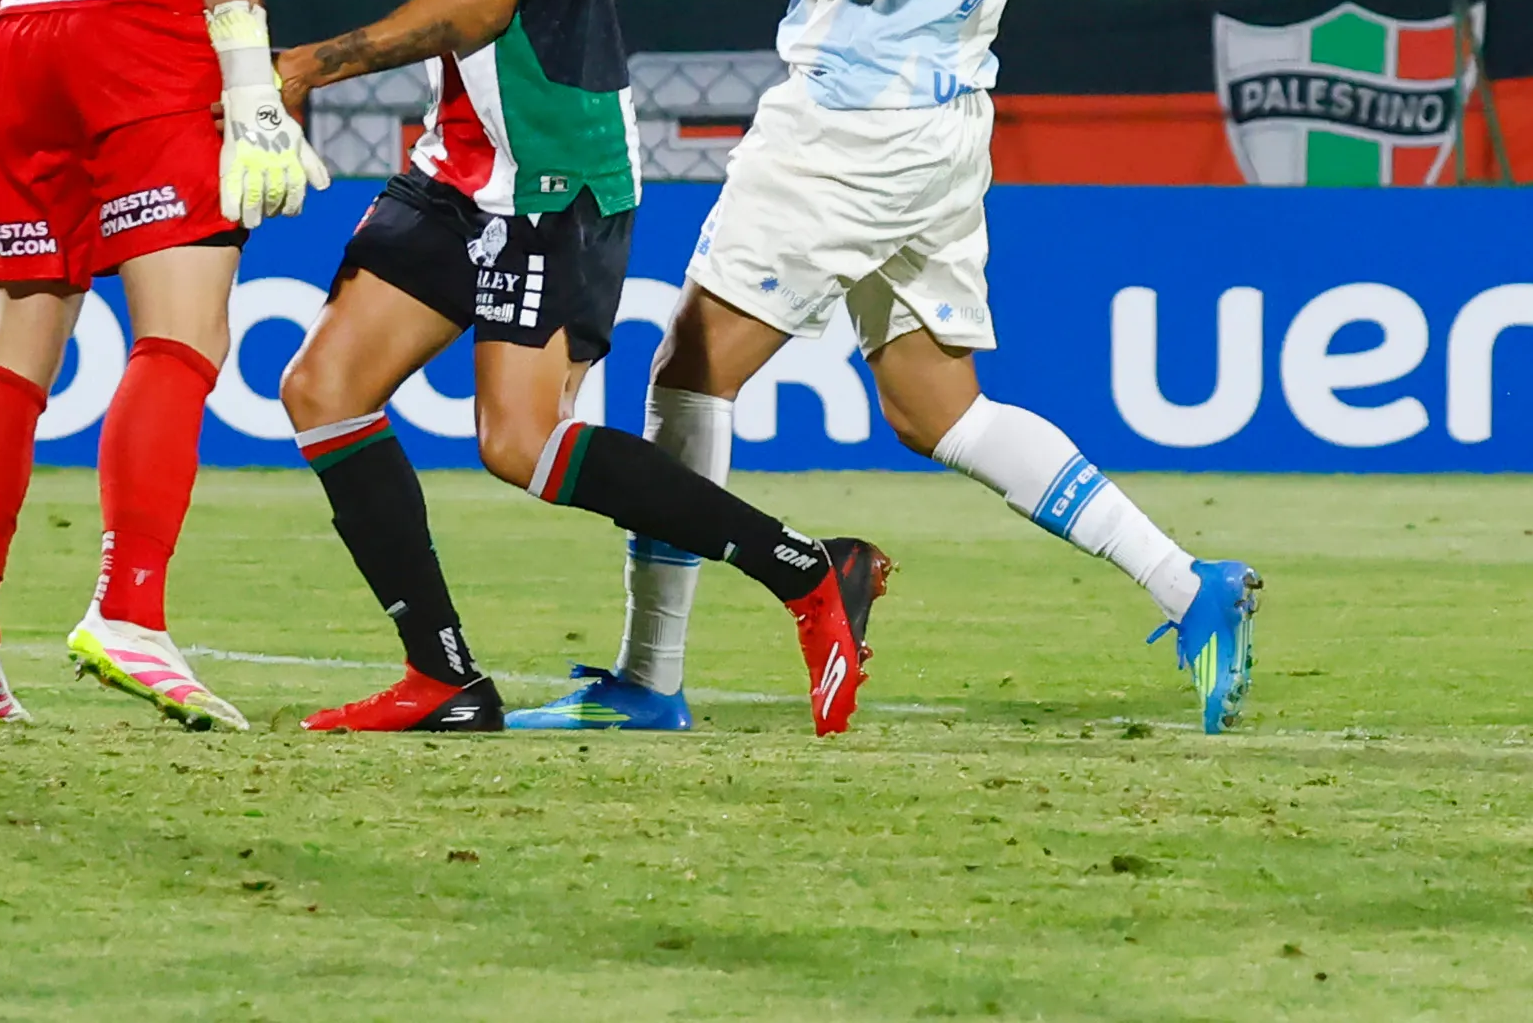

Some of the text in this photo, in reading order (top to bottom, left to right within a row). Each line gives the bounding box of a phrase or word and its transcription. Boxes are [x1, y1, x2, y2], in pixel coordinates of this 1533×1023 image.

[1239, 76, 1445, 131] PALESTINO
[99, 185, 176, 221] PUESTAS
[100, 201, 187, 238] OYAL.COM
